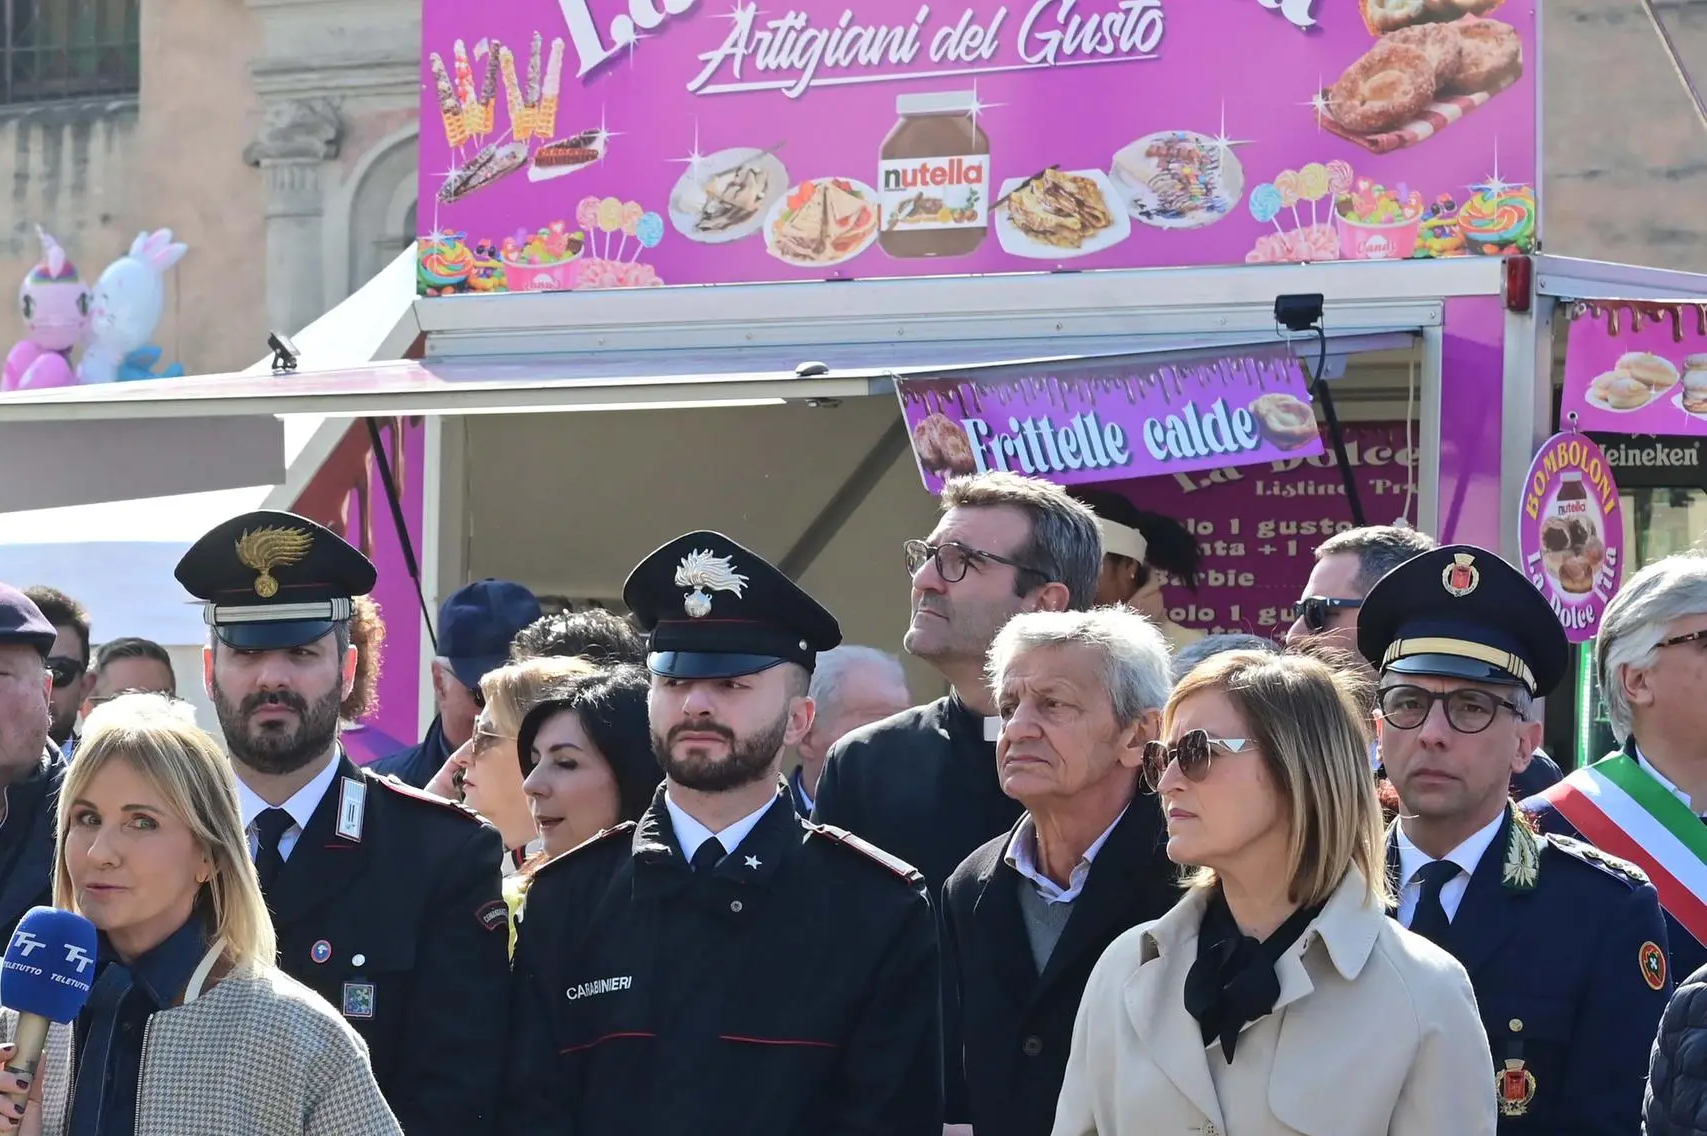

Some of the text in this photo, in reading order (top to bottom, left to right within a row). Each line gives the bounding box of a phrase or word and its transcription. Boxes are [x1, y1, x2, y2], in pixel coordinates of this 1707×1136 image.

[687, 0, 1165, 98] Artigiani del Gusto
[884, 157, 983, 188] nutella
[960, 397, 1259, 474] Frittelle calde
[1525, 441, 1617, 520] BOMBOLONI
[3, 960, 43, 976] TELETUTTO
[50, 973, 90, 992] TELETUTTO
[566, 976, 632, 1000] CARABINIERI
